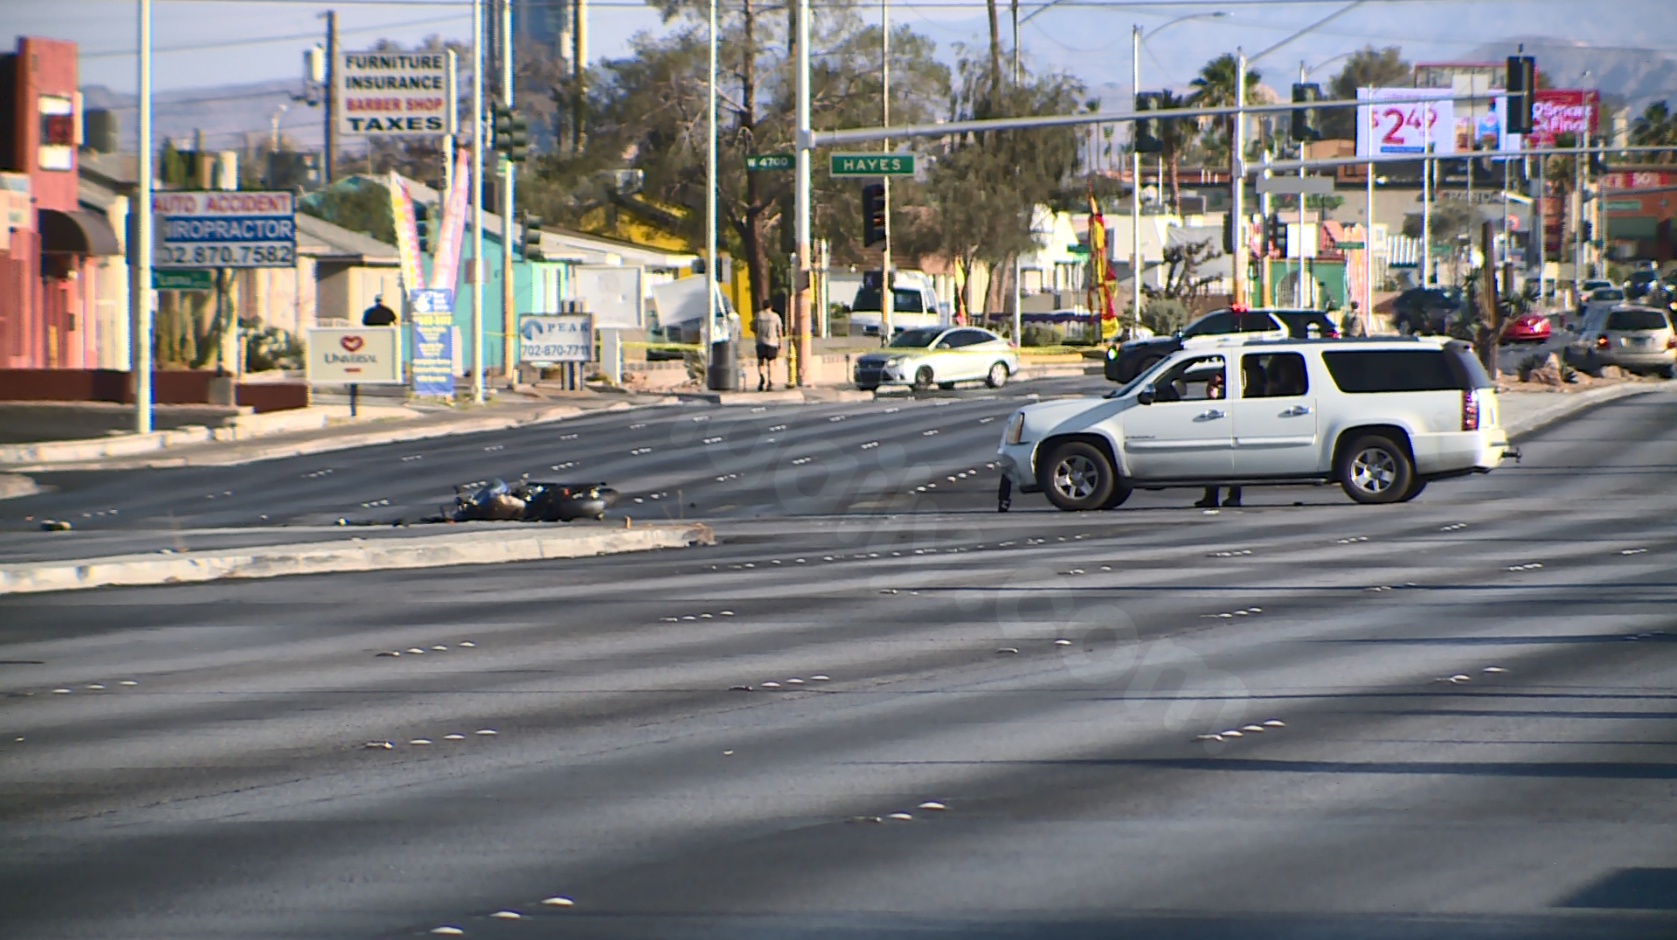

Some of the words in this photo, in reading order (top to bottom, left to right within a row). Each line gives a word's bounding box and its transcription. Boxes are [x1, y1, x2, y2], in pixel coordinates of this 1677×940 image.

[346, 55, 442, 69] FURNITURE
[346, 76, 442, 90] INSURANCE
[346, 98, 401, 111] BARBER
[406, 98, 442, 111] SHOP
[346, 117, 442, 131] TAXES
[747, 157, 756, 168] W
[843, 158, 902, 171] HAYES
[154, 195, 197, 212] AUTO
[207, 194, 290, 212] ACCIDENT
[547, 322, 590, 333] PEAK
